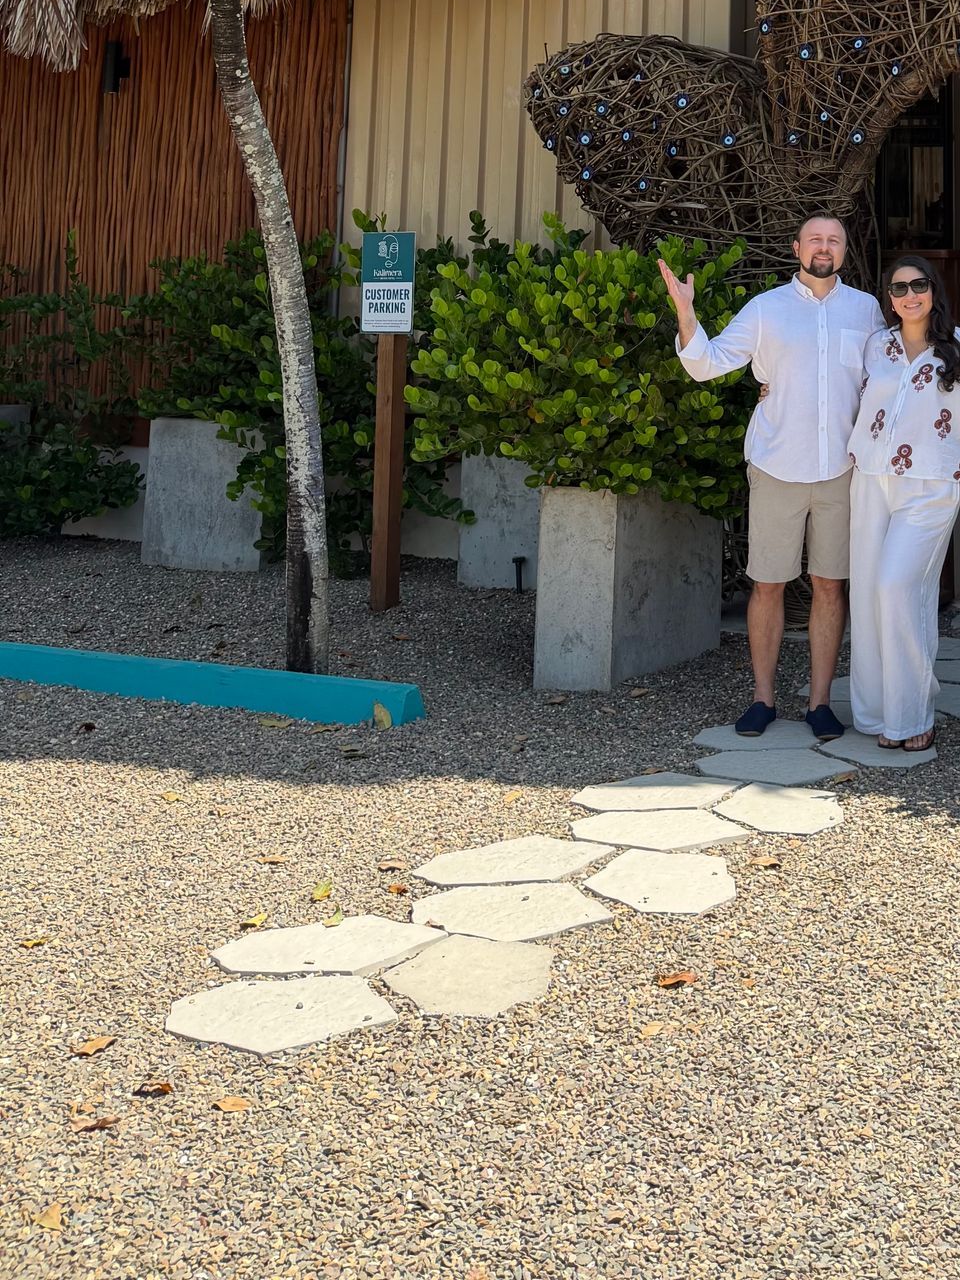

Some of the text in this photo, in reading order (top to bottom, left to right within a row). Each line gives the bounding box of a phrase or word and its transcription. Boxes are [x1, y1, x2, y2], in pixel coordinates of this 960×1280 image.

[373, 269, 402, 277] Kalimera
[365, 288, 410, 301] CUSTOMER
[368, 302, 406, 314] PARKING
